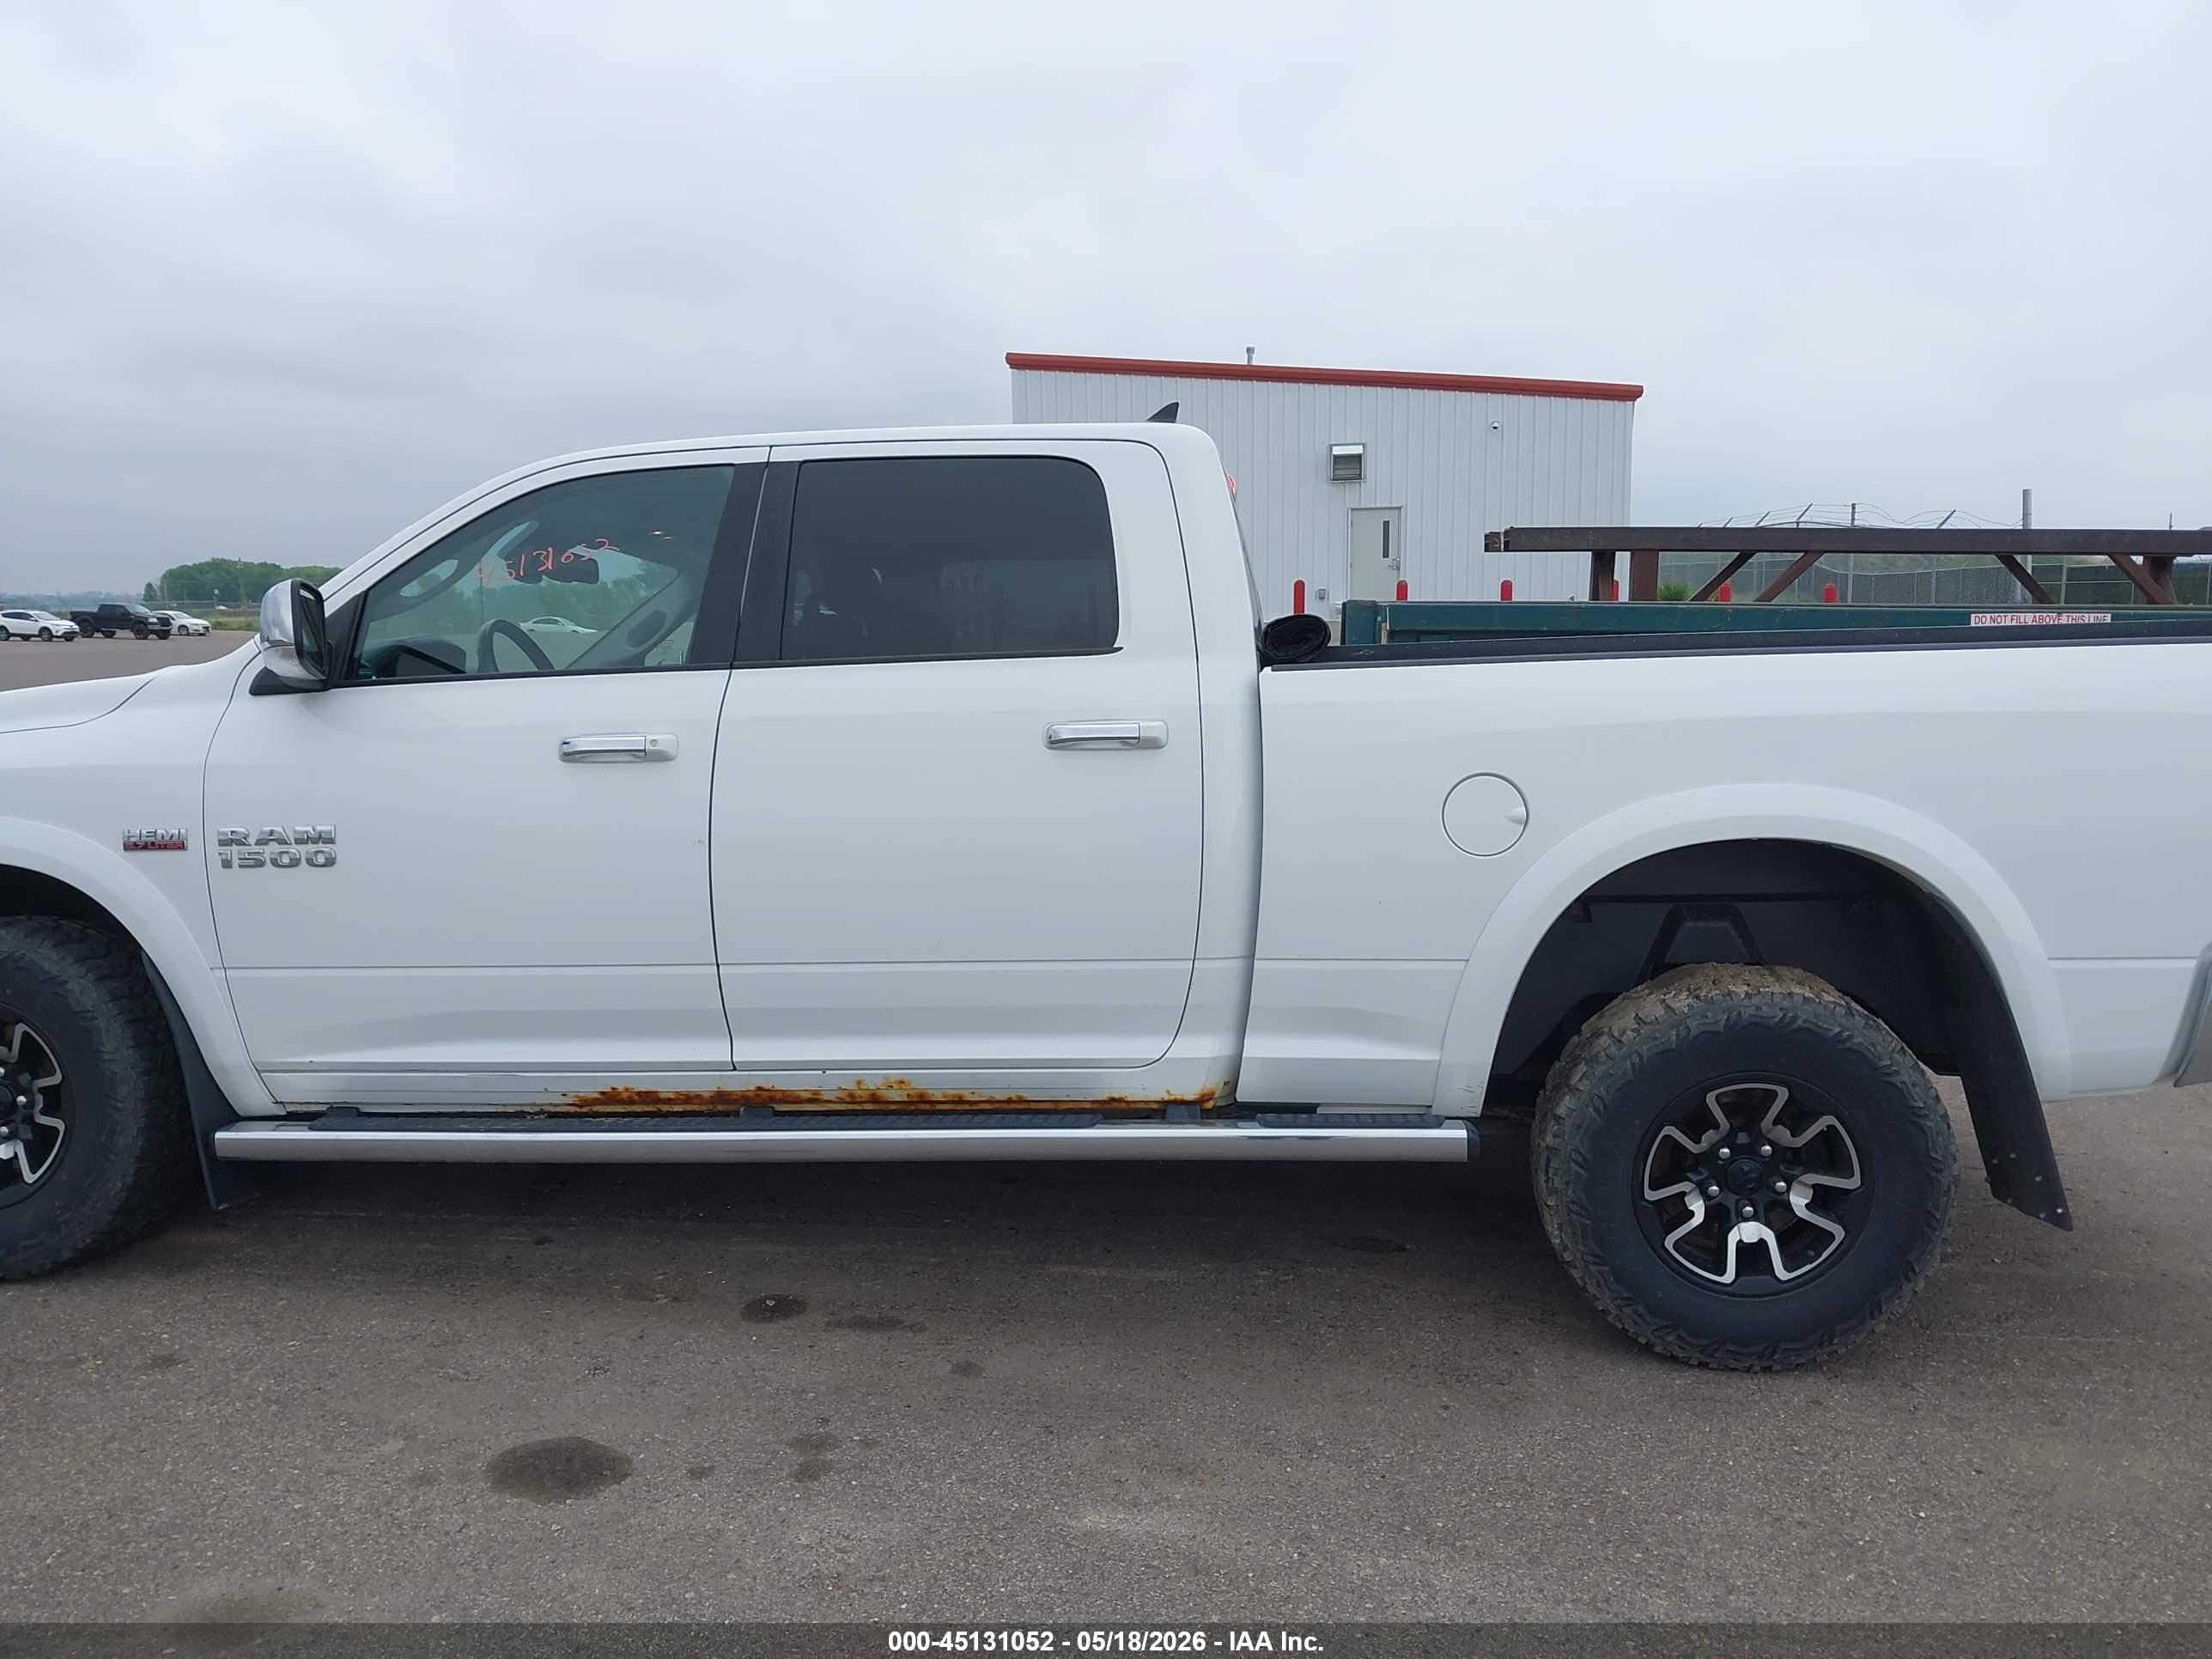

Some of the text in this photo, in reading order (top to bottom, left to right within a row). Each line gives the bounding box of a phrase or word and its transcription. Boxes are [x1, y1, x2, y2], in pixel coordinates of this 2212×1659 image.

[1974, 615, 1987, 625] DO
[1989, 614, 2008, 624] NOT
[2010, 614, 2029, 624] FILL
[2032, 614, 2063, 624] ABOVE
[2066, 614, 2086, 623] THIS
[124, 829, 186, 841] HEMI
[217, 825, 336, 847] RAM
[218, 848, 337, 869] 1500
